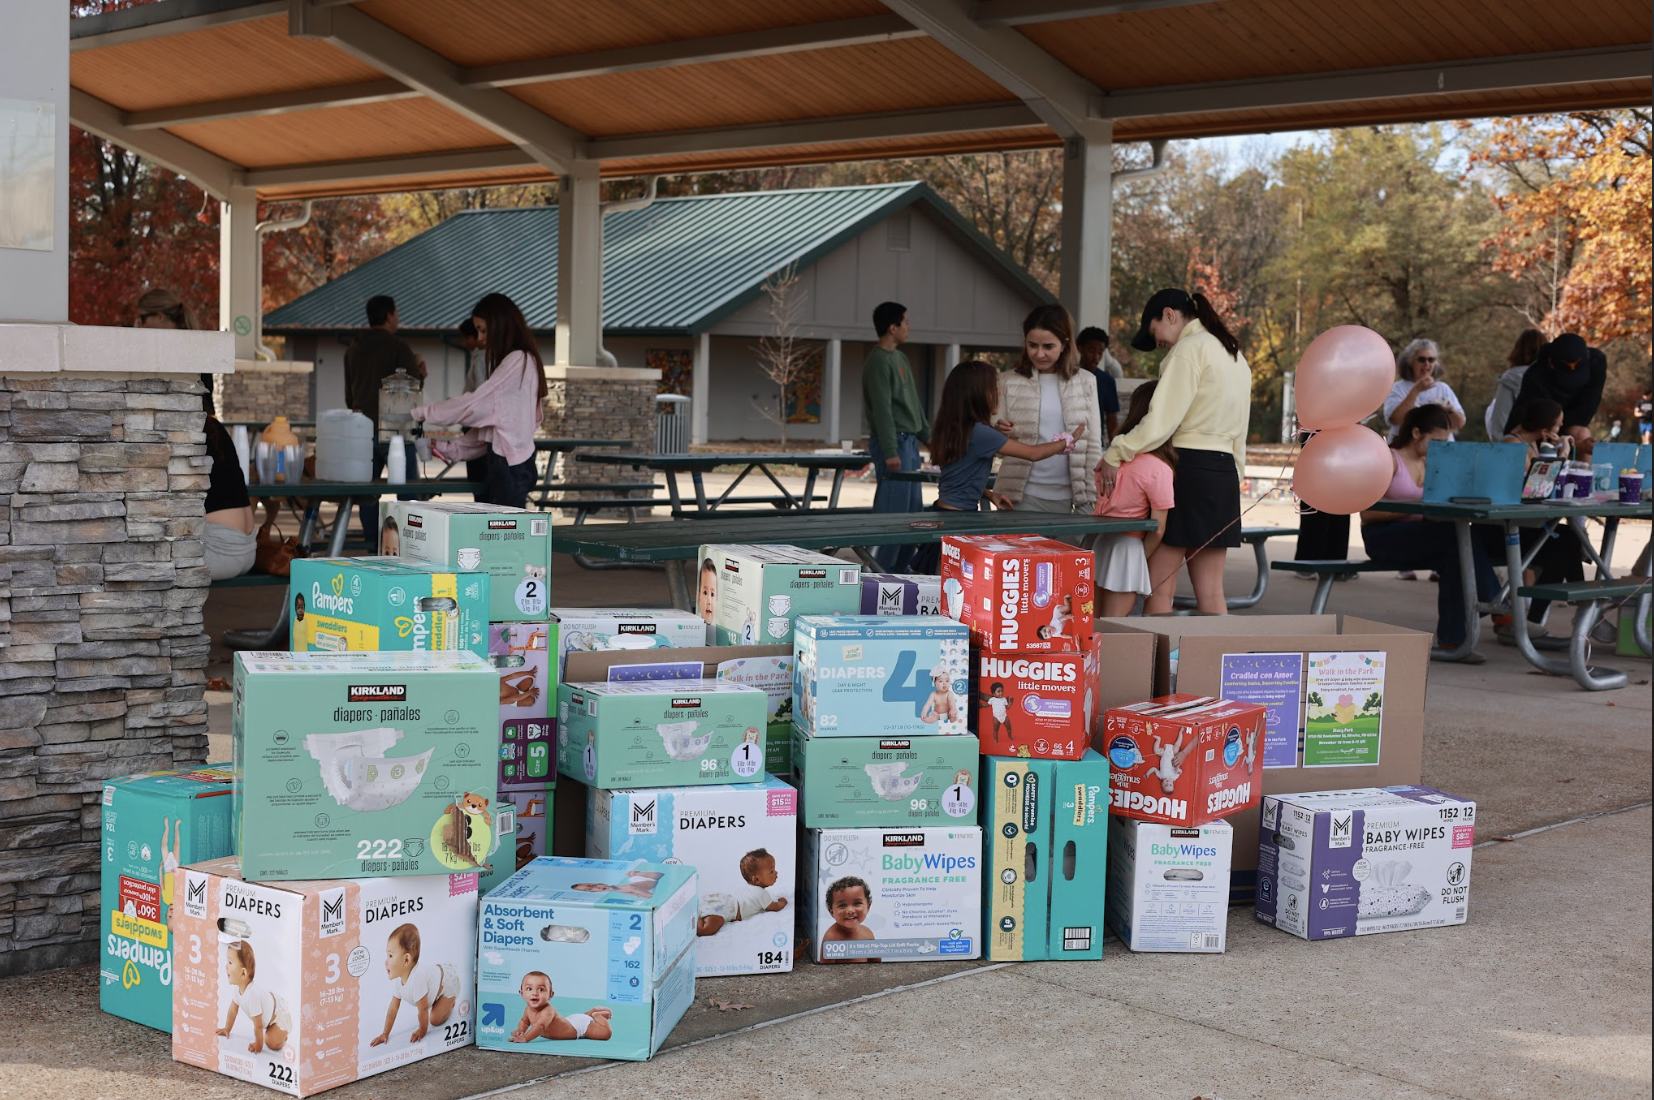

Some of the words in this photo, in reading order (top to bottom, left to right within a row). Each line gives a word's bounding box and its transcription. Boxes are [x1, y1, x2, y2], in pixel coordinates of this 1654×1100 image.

[480, 532, 500, 541] diapers
[1022, 559, 1030, 587] movers
[526, 582, 536, 598] 2
[790, 580, 809, 588] diapers
[465, 587, 471, 595] 96
[313, 582, 353, 615] Pampers
[1001, 559, 1019, 649] HUGGIES
[317, 620, 347, 633] swaddlers
[820, 667, 885, 679] DIAPERS
[981, 657, 1076, 682] HUGGIES
[351, 686, 404, 695] KIRKLAND
[883, 651, 932, 718] 4
[1018, 681, 1039, 691] little
[1041, 683, 1076, 693] movers
[333, 707, 372, 722] diapers
[380, 706, 420, 721] pañales
[664, 711, 684, 719] diapers
[687, 710, 709, 719] pañales
[820, 715, 837, 726] 82
[1107, 719, 1115, 730] 2
[530, 746, 545, 757] 5
[742, 745, 749, 760] 1
[1066, 741, 1074, 752] 4
[872, 751, 892, 760] diapers
[701, 759, 717, 770] 96
[953, 786, 961, 801] 1
[1207, 782, 1250, 813] HUGGIES
[910, 799, 927, 810] 96
[1086, 785, 1100, 824] Pampers
[1294, 810, 1304, 819] 1152
[1305, 814, 1311, 822] 12
[1439, 808, 1458, 818] 1152
[1464, 807, 1473, 817] 12
[106, 823, 115, 832] 124
[680, 815, 746, 830] DIAPERS
[1367, 821, 1400, 830] PREMIUM
[1282, 824, 1293, 833] BABY
[1295, 828, 1308, 838] WIPES
[1366, 829, 1401, 845] BABY
[1406, 827, 1445, 840] WIPES
[356, 839, 402, 859] 222
[1151, 844, 1216, 859] BabyWipes
[1366, 842, 1425, 853] FRAGRANCE-FREE
[107, 847, 114, 862] 3
[361, 859, 387, 872] diapers
[392, 858, 418, 870] pañales
[882, 853, 976, 874] BabyWipes
[123, 879, 147, 892] protection
[226, 884, 256, 897] PREMIUM
[1441, 887, 1451, 896] DO
[1454, 886, 1468, 894] NOT
[186, 901, 206, 911] Member's
[225, 893, 281, 919] DIAPERS
[366, 895, 398, 909] PREMIUM
[1443, 896, 1465, 904] FLUSH
[365, 897, 424, 924] DIAPERS
[484, 904, 554, 919] Absorbent
[116, 917, 163, 940] swaddlers
[321, 920, 344, 930] Member's
[484, 919, 493, 929] &
[497, 919, 524, 931] Soft
[629, 914, 641, 930] 2
[1003, 918, 1013, 928] #1
[484, 932, 533, 946] Diapers
[188, 935, 202, 964] 3
[826, 944, 845, 952] 900
[107, 933, 172, 986] Pampers
[624, 960, 640, 968] 162
[758, 951, 783, 964] 184
[325, 953, 340, 984] 3
[444, 1021, 467, 1041] 222
[481, 1026, 505, 1035] up&up
[446, 1037, 465, 1047] DIAPERS
[268, 1062, 293, 1084] 222
[271, 1078, 291, 1089] DIAPERS
